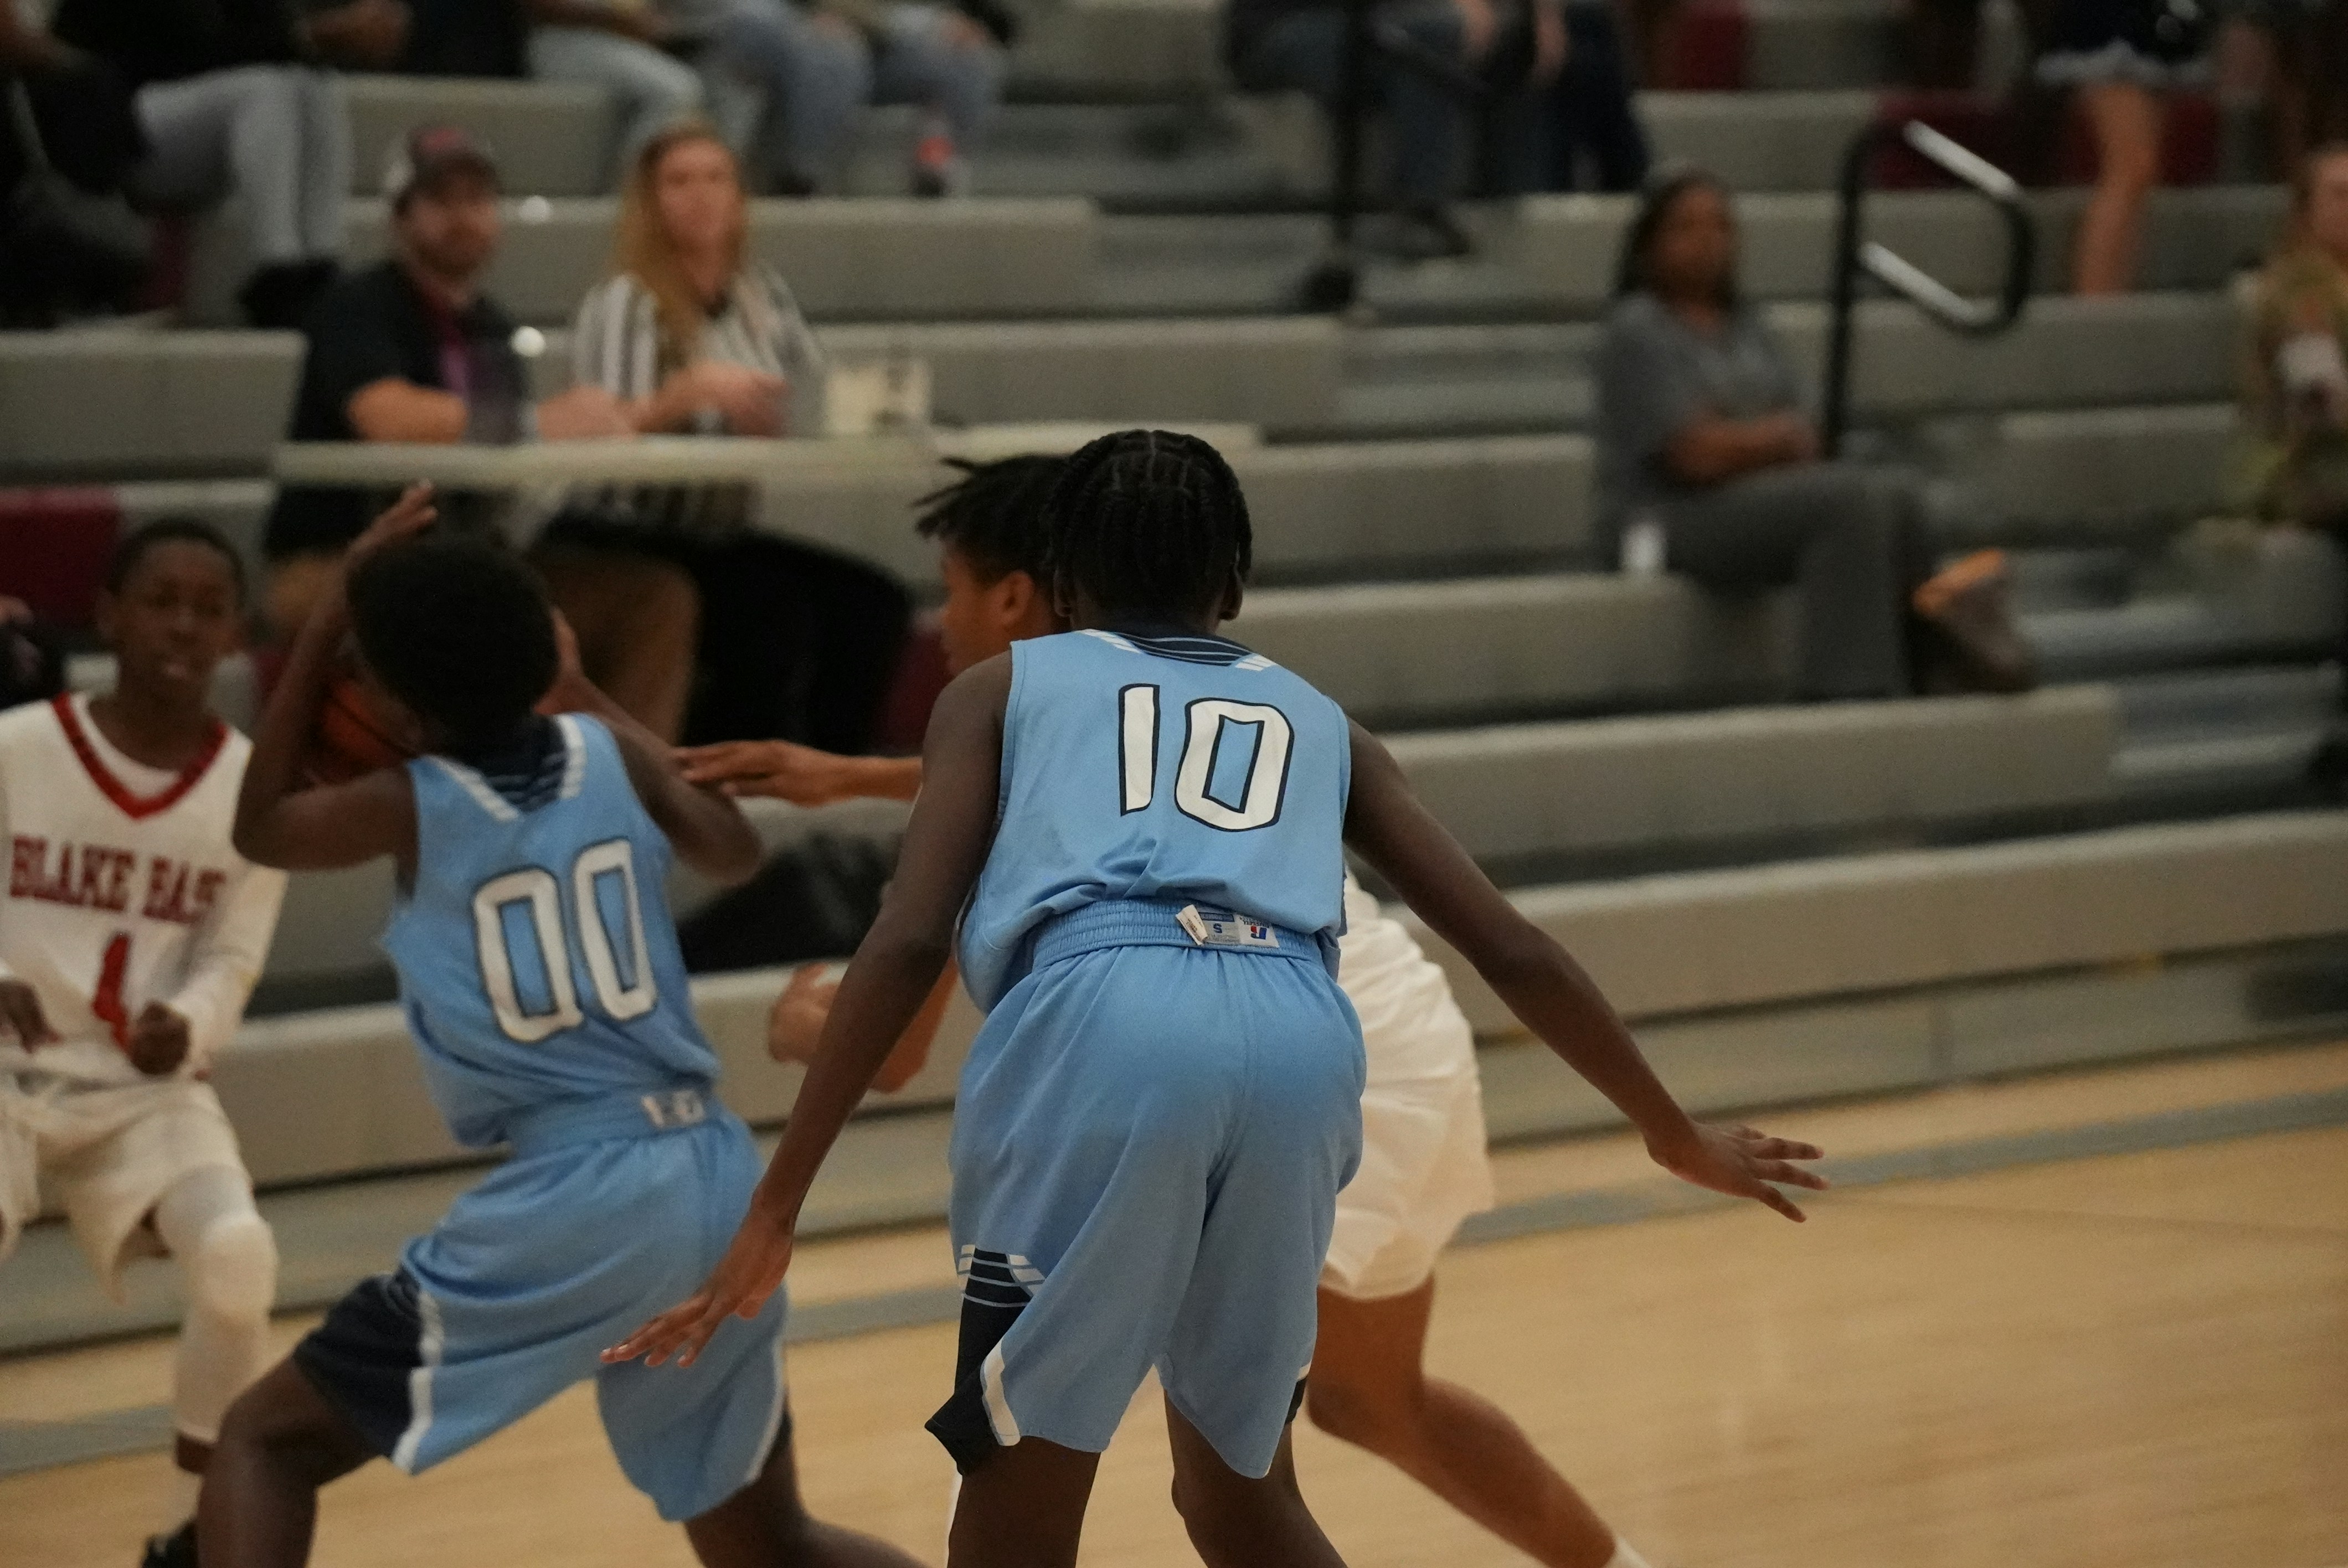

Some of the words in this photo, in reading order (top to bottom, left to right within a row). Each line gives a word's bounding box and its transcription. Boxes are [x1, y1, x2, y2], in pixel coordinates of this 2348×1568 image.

[1118, 683, 1295, 832] 10
[9, 835, 135, 914] BLAKE
[1213, 923, 1223, 933] S
[91, 932, 132, 1055] 1
[471, 836, 657, 1044] 00
